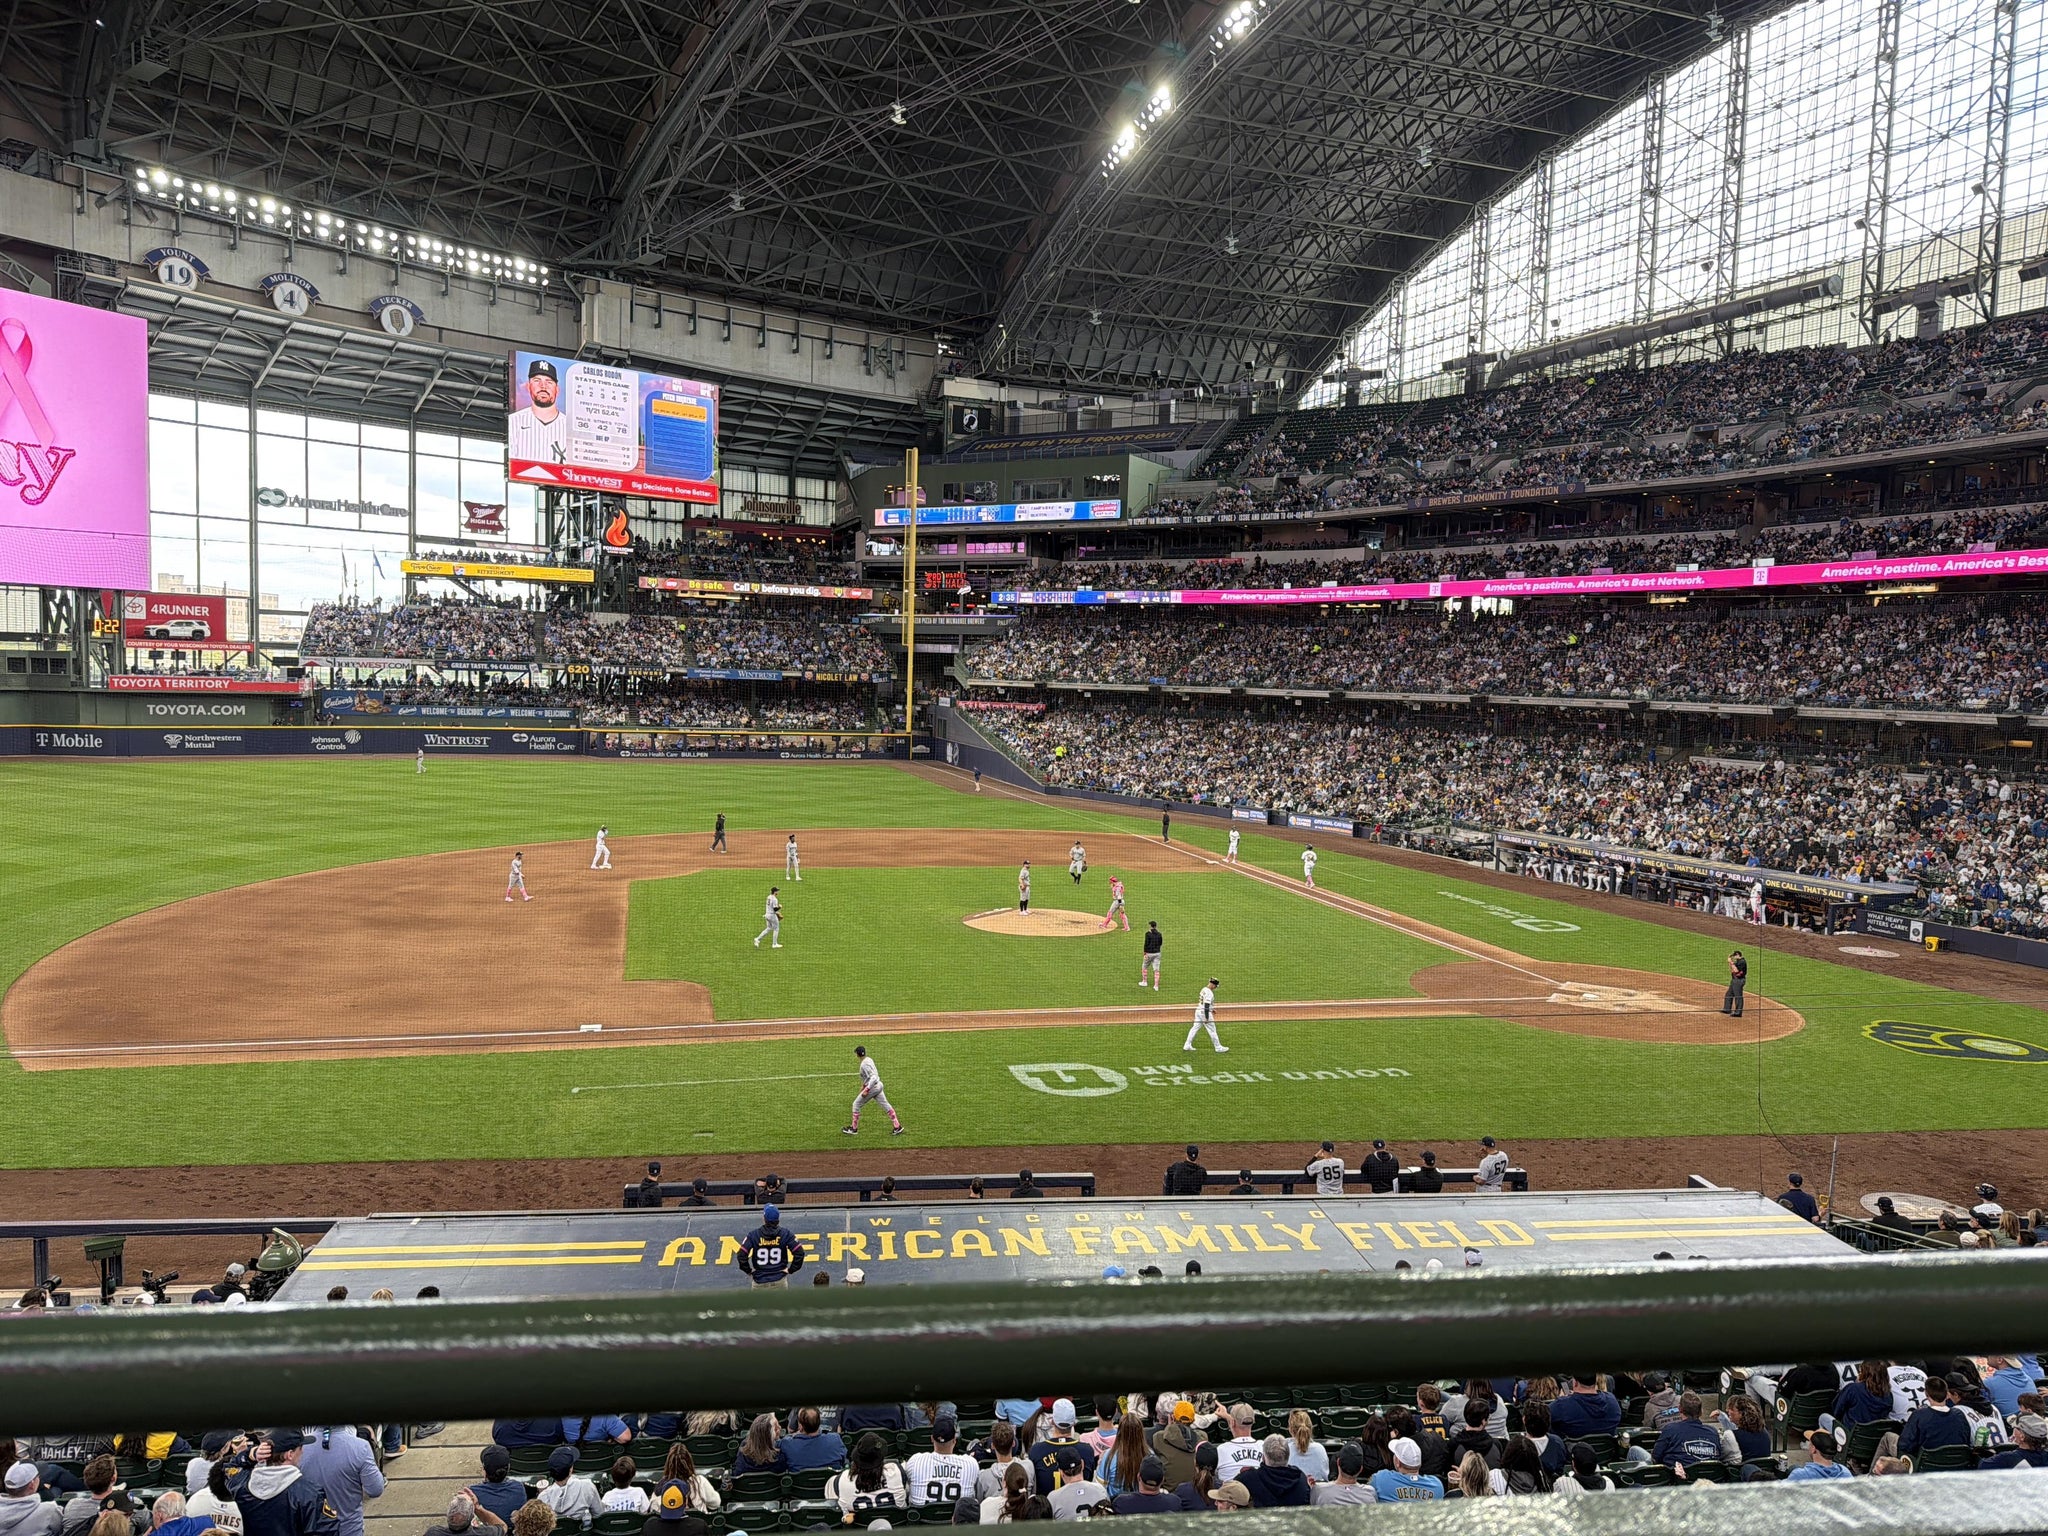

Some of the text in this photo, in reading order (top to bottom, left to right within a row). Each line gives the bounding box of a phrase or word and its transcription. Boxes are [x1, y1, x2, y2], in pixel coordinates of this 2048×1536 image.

[160, 248, 195, 263] YOUNT
[164, 264, 193, 285] 19
[270, 274, 312, 291] MOLITOR
[282, 290, 297, 309] 4
[380, 297, 412, 308] UECKER
[583, 366, 603, 377] CARLOS
[982, 440, 1018, 449] MUST
[1040, 438, 1054, 446] IN
[1058, 436, 1084, 444] THE
[1086, 434, 1132, 442] FRONT
[1134, 432, 1174, 440] ROW!
[632, 481, 642, 490] Big
[643, 483, 673, 493] Decisions,
[1428, 486, 1559, 506] BREWERS COMMUNITY FOUNDATION
[292, 495, 409, 517] Aurora Health Care
[740, 496, 802, 514] Johnsonville
[1821, 565, 1882, 579] America's
[1884, 562, 1941, 577] pastime.
[1944, 556, 2015, 571] America's
[689, 580, 821, 596] Be safe. Call before you dig.
[1484, 575, 1705, 592] America's pastime. America's Best Network.
[1354, 589, 1390, 597] Network.
[150, 604, 210, 617] 4RUNNER
[93, 619, 119, 633] 0:22
[567, 665, 626, 675] 620 WTMJ
[738, 670, 778, 680] WINTRUST
[112, 678, 230, 689] TOYOTA TERRITORY
[816, 672, 858, 682] NICOLET LAW
[147, 704, 246, 716] TOYOTA.COM
[421, 707, 448, 716] WELCOME
[456, 707, 484, 716] DELICIOUS
[510, 708, 536, 717] WELCOME
[544, 709, 570, 718] DELICIOUS
[52, 733, 103, 748] Mobile
[185, 734, 242, 742] Northwestern
[311, 736, 341, 745] Johnson
[424, 734, 490, 746] WINTRUST
[530, 735, 556, 743] Aurora
[529, 742, 555, 750] Health
[1503, 836, 1521, 844] GRUBER
[1601, 851, 1636, 863] GRUBER LAW
[1695, 868, 1708, 876] ALL!
[1829, 889, 1844, 898] ALL!
[1867, 918, 1888, 927] HITTERS
[1885, 916, 1903, 924] HEAVY
[1128, 1062, 1194, 1076] uw
[1144, 1066, 1414, 1086] credit union
[1322, 1166, 1341, 1181] 85
[1494, 1160, 1507, 1174] 67
[1066, 1222, 1321, 1255] FAMILY
[1336, 1219, 1535, 1250] FIELD
[756, 1248, 781, 1266] 99
[1421, 1416, 1443, 1426] YELICH
[1986, 1422, 2004, 1445] 8
[1231, 1449, 1263, 1462] UECKER
[932, 1466, 962, 1479] JUDGE
[927, 1481, 961, 1502] 99
[1396, 1488, 1434, 1501] UECKER
[212, 1514, 241, 1528] URNES
